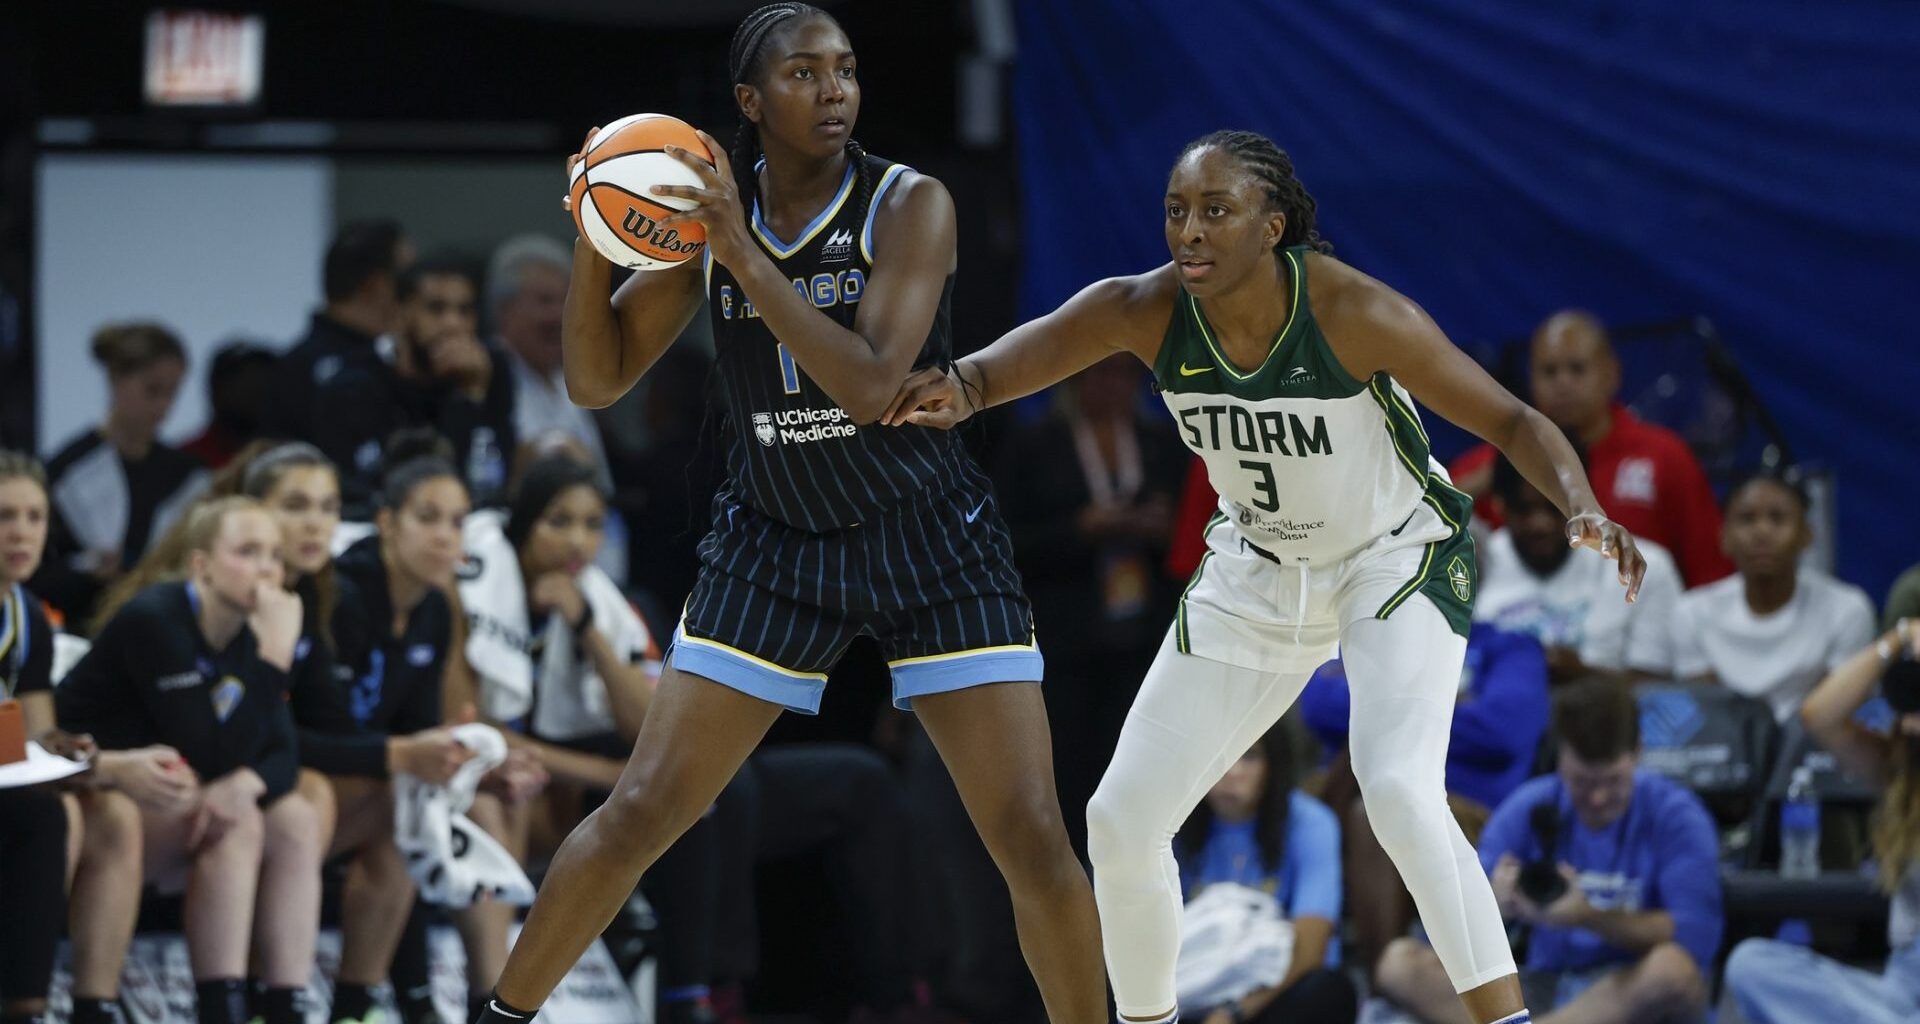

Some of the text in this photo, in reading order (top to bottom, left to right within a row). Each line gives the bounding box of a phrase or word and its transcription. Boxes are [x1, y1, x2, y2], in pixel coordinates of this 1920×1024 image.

[721, 269, 866, 320] CAGO
[777, 342, 800, 395] 1
[1280, 375, 1316, 387] SYMETRA
[780, 423, 857, 445] Medicine
[1179, 405, 1333, 457] STORM
[1239, 460, 1280, 513] 3
